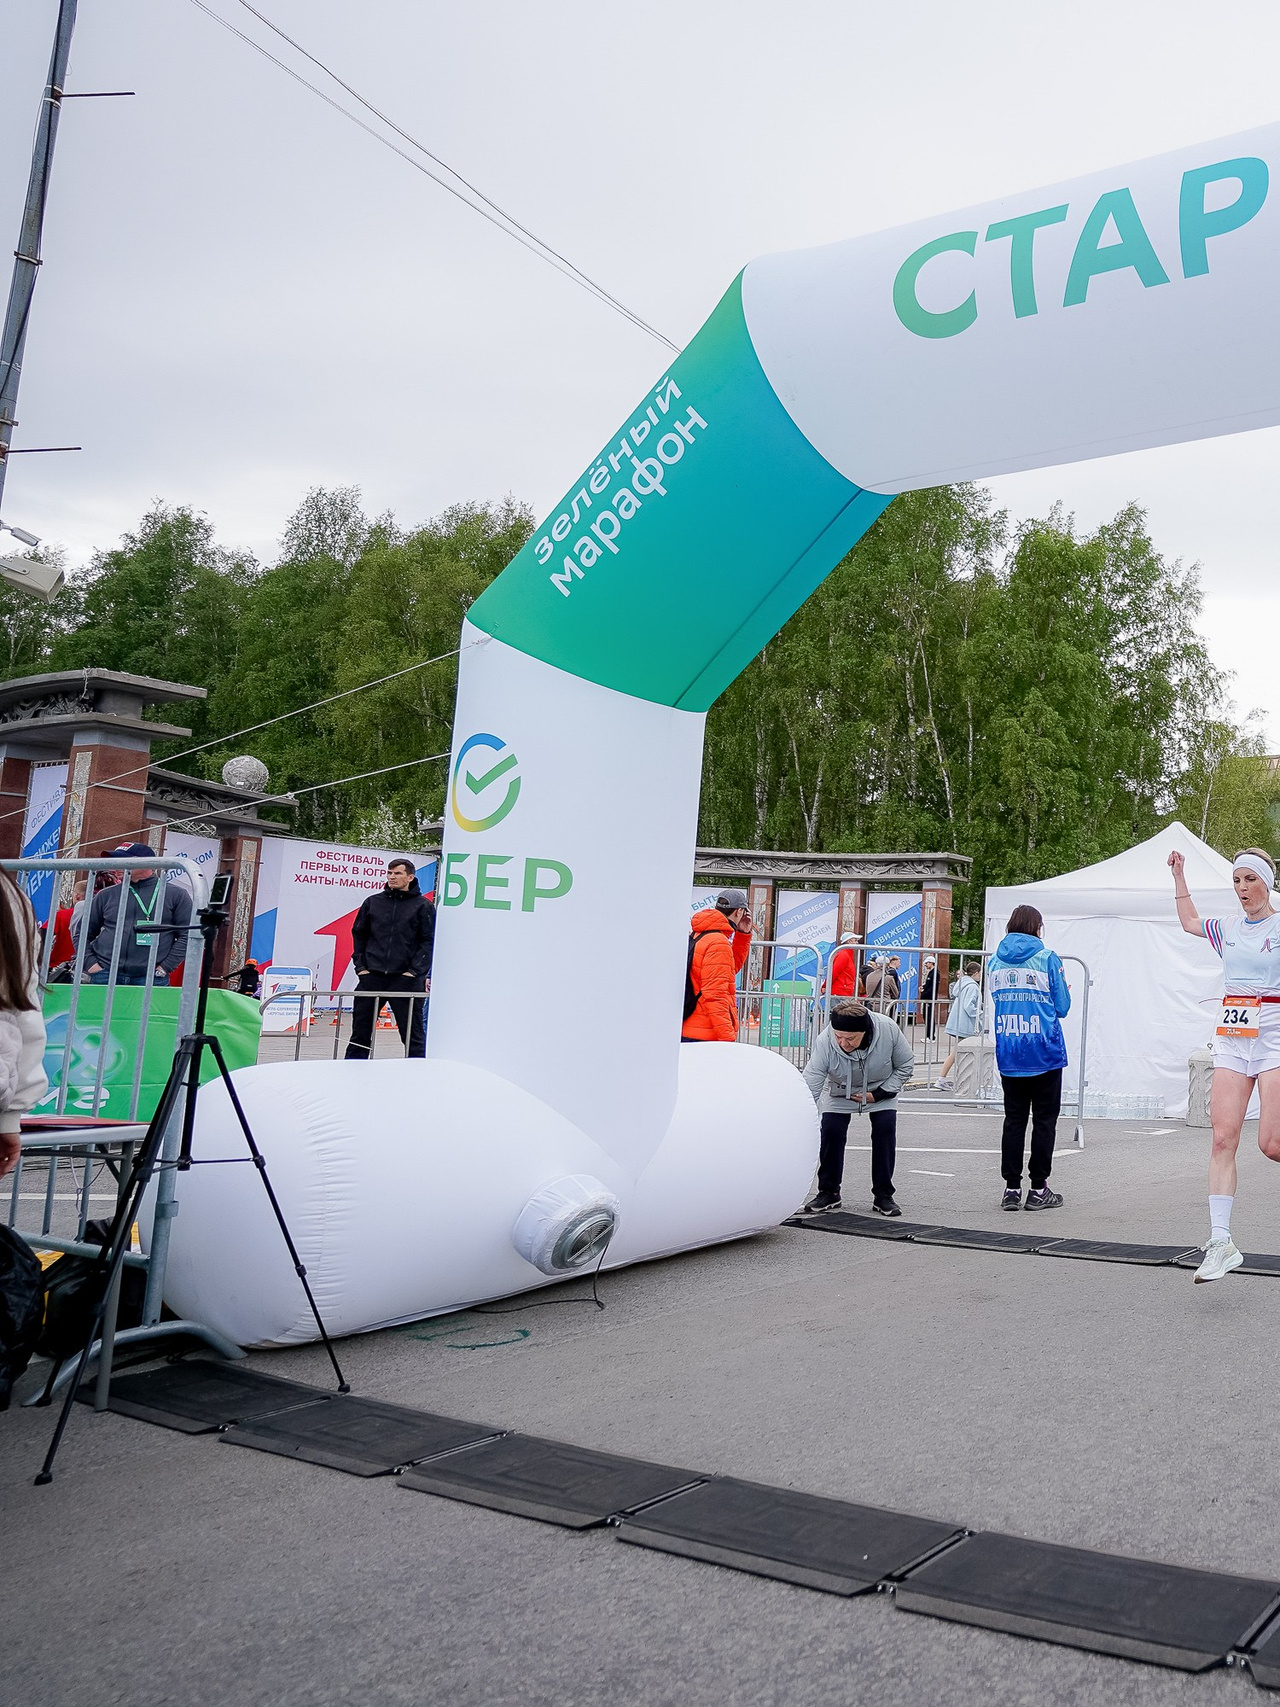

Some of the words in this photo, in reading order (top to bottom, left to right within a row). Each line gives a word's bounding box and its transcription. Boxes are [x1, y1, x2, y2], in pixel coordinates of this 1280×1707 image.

[534, 376, 683, 565] зелёный
[550, 405, 708, 598] марафон
[300, 861, 348, 874] ПЕРВЫХ
[352, 866, 359, 875] В
[363, 868, 387, 878] ЮГР
[316, 850, 384, 866] ФЕСТИВАЛЬ
[294, 874, 386, 890] ХАНТЫ-МАНСИЙ
[437, 853, 573, 913] БЕР
[781, 913, 803, 928] БЫТЬ
[803, 897, 834, 917] ВМЕСТЕ
[871, 899, 911, 925] ФЕСТИВАЛЬ
[873, 916, 918, 946] ДВИЖЕНИЕ
[1223, 1009, 1249, 1025] 234
